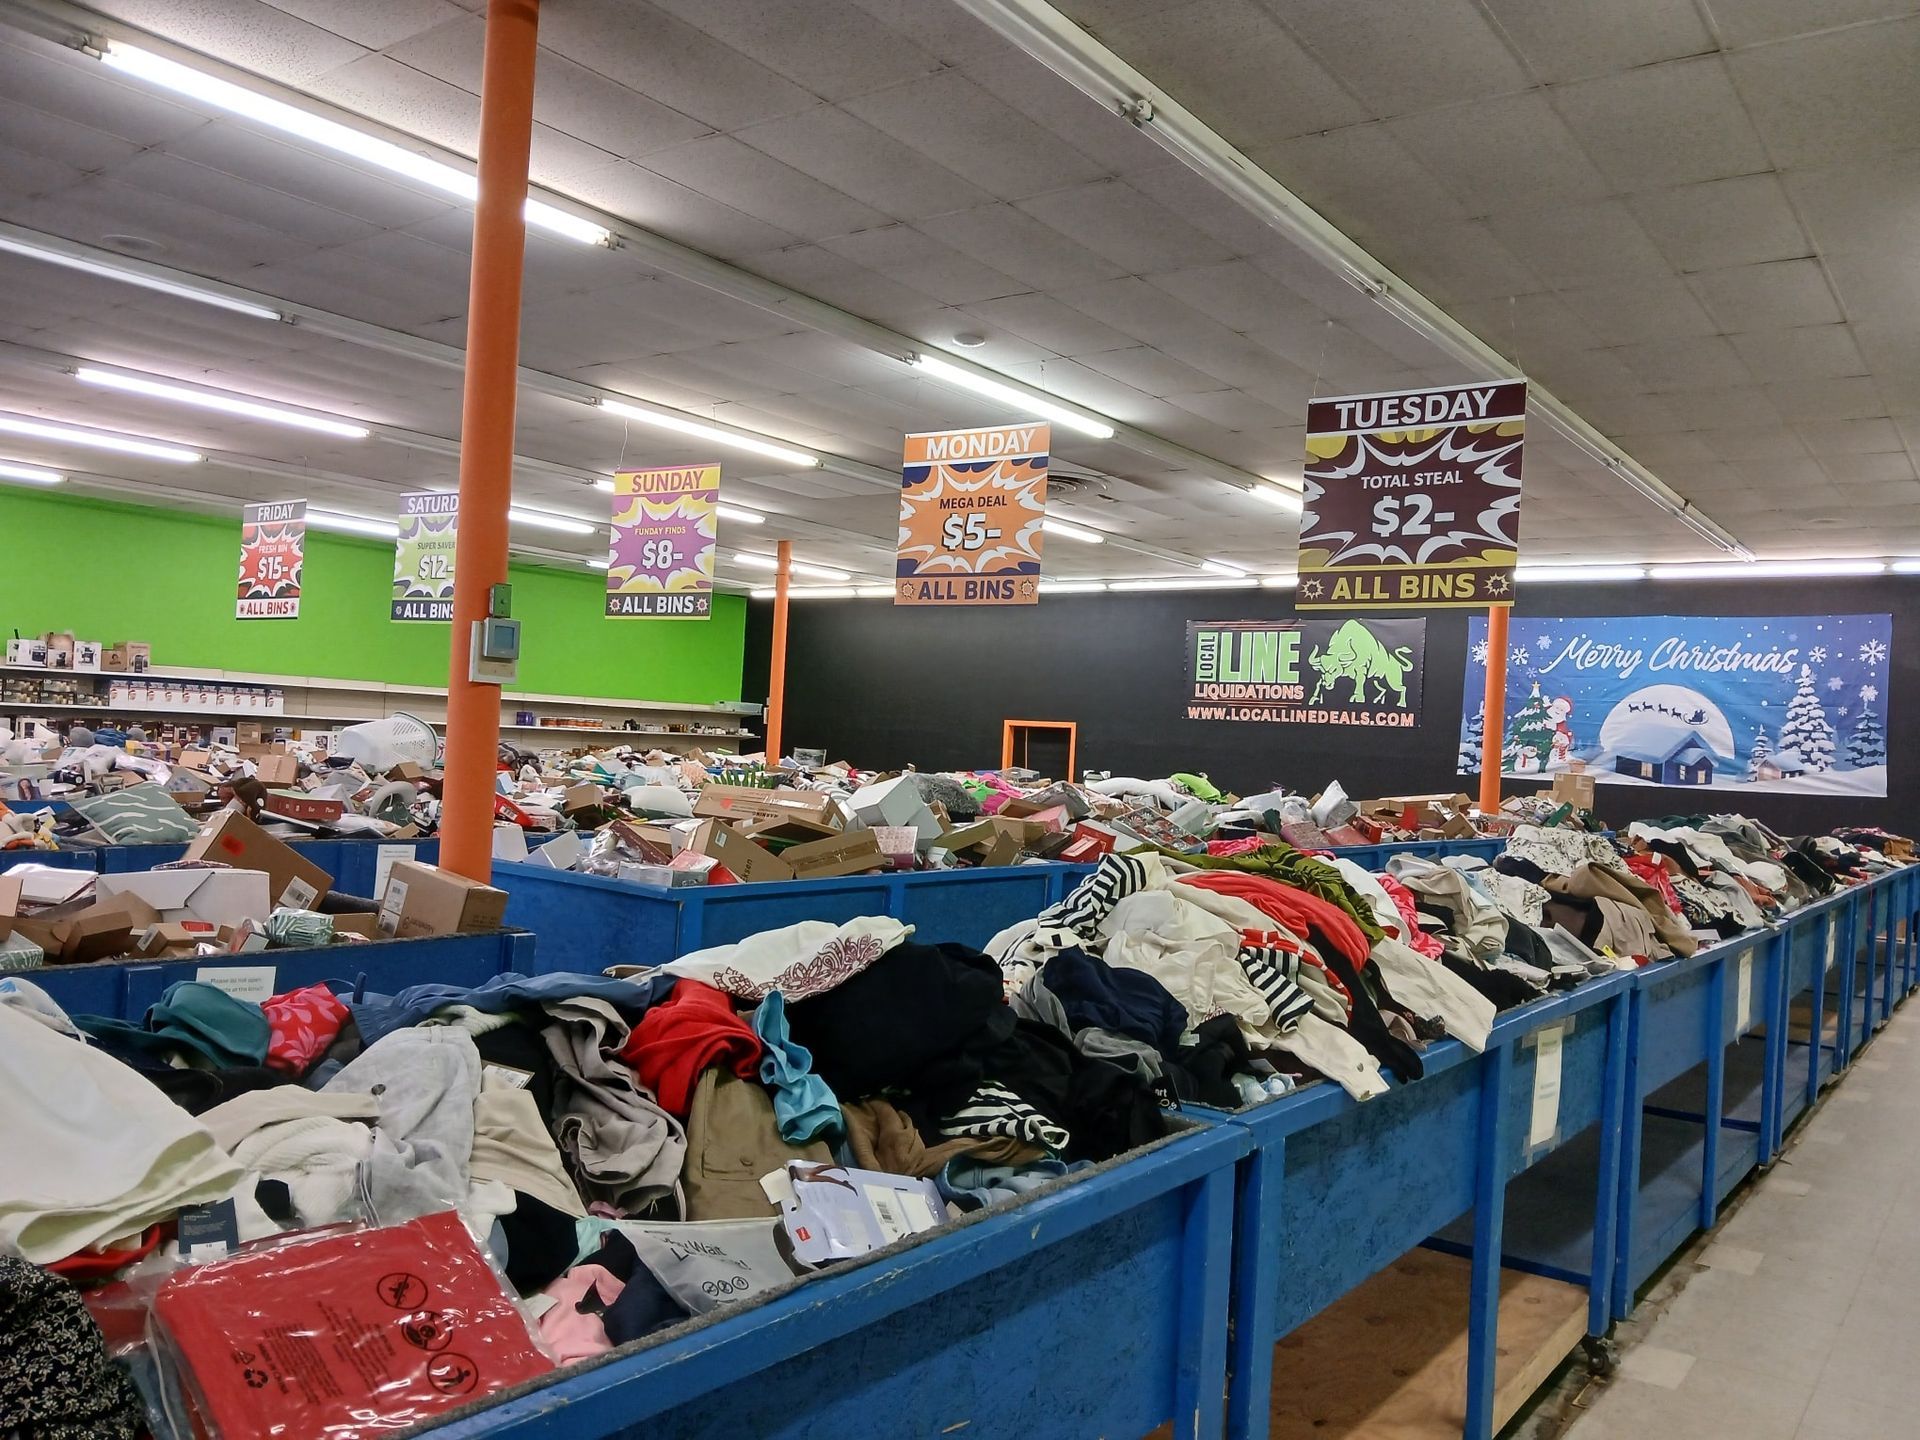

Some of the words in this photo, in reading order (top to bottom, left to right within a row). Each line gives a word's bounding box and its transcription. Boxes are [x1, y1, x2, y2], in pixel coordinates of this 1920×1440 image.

[1335, 389, 1497, 429] TUESDAY
[926, 428, 1036, 460] MONDAY
[631, 470, 704, 493] SUNDAY
[1361, 474, 1410, 489] TOTAL
[1414, 470, 1463, 486] STEAL
[257, 504, 294, 521] FRIDAY
[407, 495, 459, 514] SATURD
[939, 497, 974, 509] MEGA
[978, 495, 1007, 508] DEAL
[1372, 493, 1455, 537] $2-
[635, 527, 664, 535] FUNDAY
[665, 525, 686, 534] FINDS
[941, 512, 1001, 551] $5-
[258, 545, 277, 553] FRESH
[417, 542, 436, 550] SUPER
[641, 538, 683, 570] $8-
[257, 556, 289, 580] $15-
[418, 554, 454, 580] $12-
[918, 581, 957, 600] ALL
[964, 580, 1015, 600] BINS
[1330, 575, 1390, 600] ALL
[1399, 573, 1475, 599] BINS
[246, 602, 264, 615] ALL
[267, 602, 289, 615] BINS
[403, 603, 427, 618] ALL
[621, 597, 652, 613] ALL
[656, 595, 694, 613] BINS
[1199, 635, 1216, 680] LOCAL
[1219, 631, 1301, 684] LINE
[1538, 636, 1643, 680] Merry
[1648, 637, 1799, 674] Christmas
[1195, 683, 1305, 700] LIQUIDATIONS
[1187, 706, 1415, 727] WWW.LOCALLINEDEALS.COM
